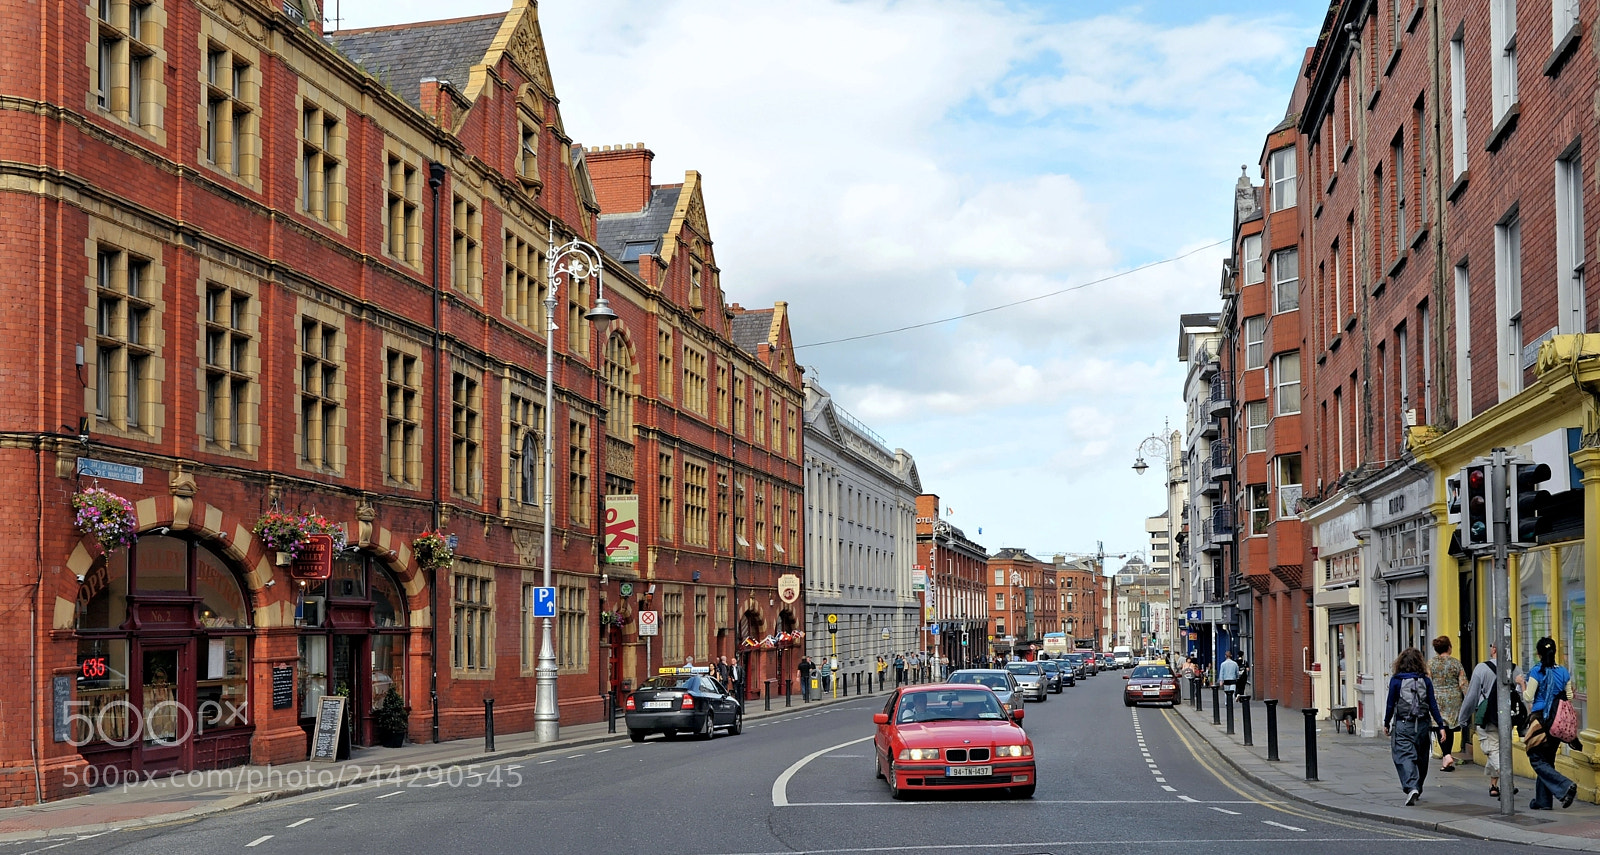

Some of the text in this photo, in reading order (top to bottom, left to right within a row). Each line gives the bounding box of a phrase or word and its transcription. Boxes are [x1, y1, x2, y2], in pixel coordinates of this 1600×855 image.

[138, 471, 142, 480] 2
[916, 516, 933, 525] OTEL
[304, 544, 325, 552] OPPER
[300, 553, 323, 561] ALLEY
[539, 589, 549, 603] P
[166, 610, 171, 622] 2
[82, 657, 106, 677] €35
[953, 767, 989, 776] 94-TN-1437
